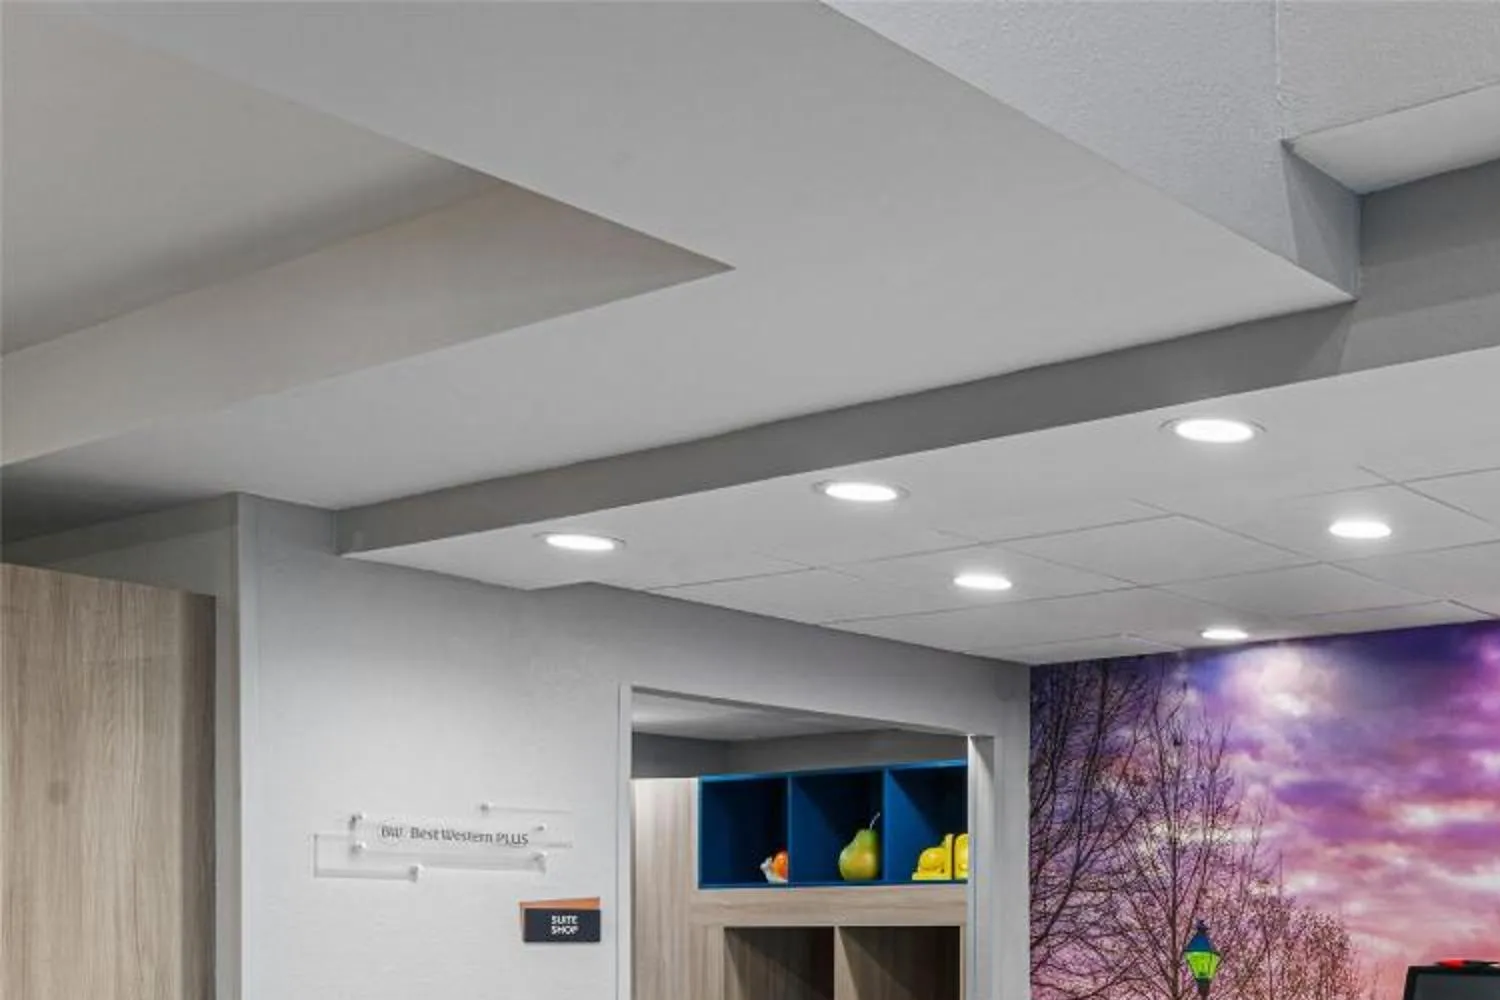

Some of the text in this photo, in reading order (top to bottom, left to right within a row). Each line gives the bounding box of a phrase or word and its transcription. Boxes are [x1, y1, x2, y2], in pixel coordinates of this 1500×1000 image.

[410, 826, 439, 841] Best
[441, 828, 493, 844] Western
[495, 831, 529, 846] PLUS
[551, 914, 579, 925] SUITE
[551, 925, 579, 936] SHOP
